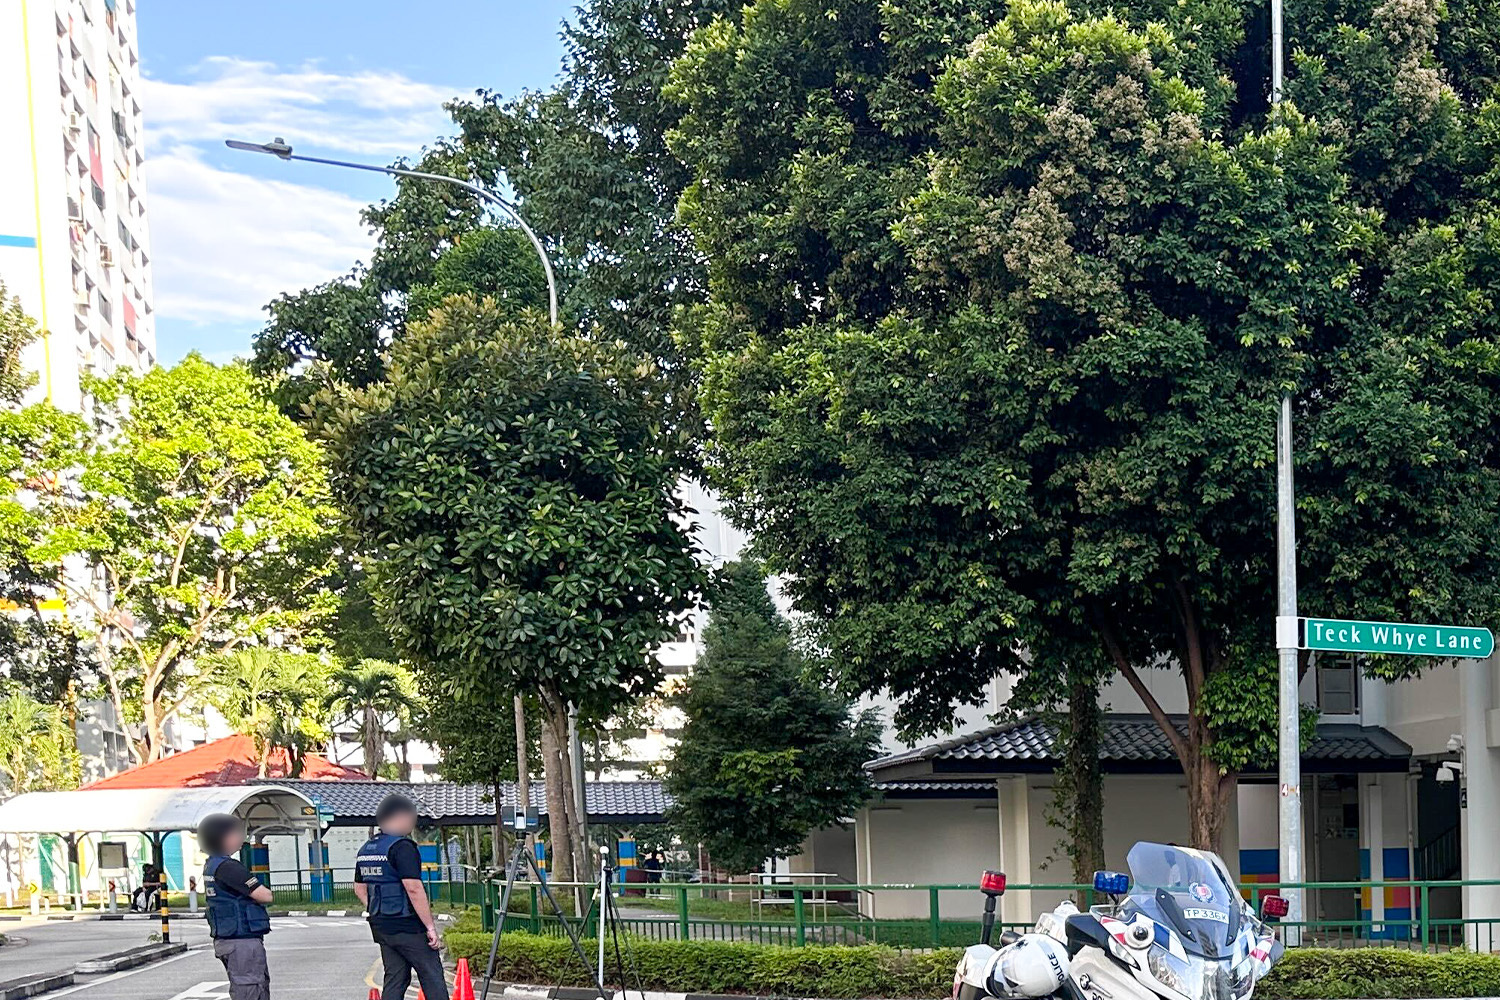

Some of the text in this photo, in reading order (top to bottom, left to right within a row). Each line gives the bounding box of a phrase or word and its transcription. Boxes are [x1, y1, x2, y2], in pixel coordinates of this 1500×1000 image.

[1313, 623, 1482, 650] Teck Whye Lane
